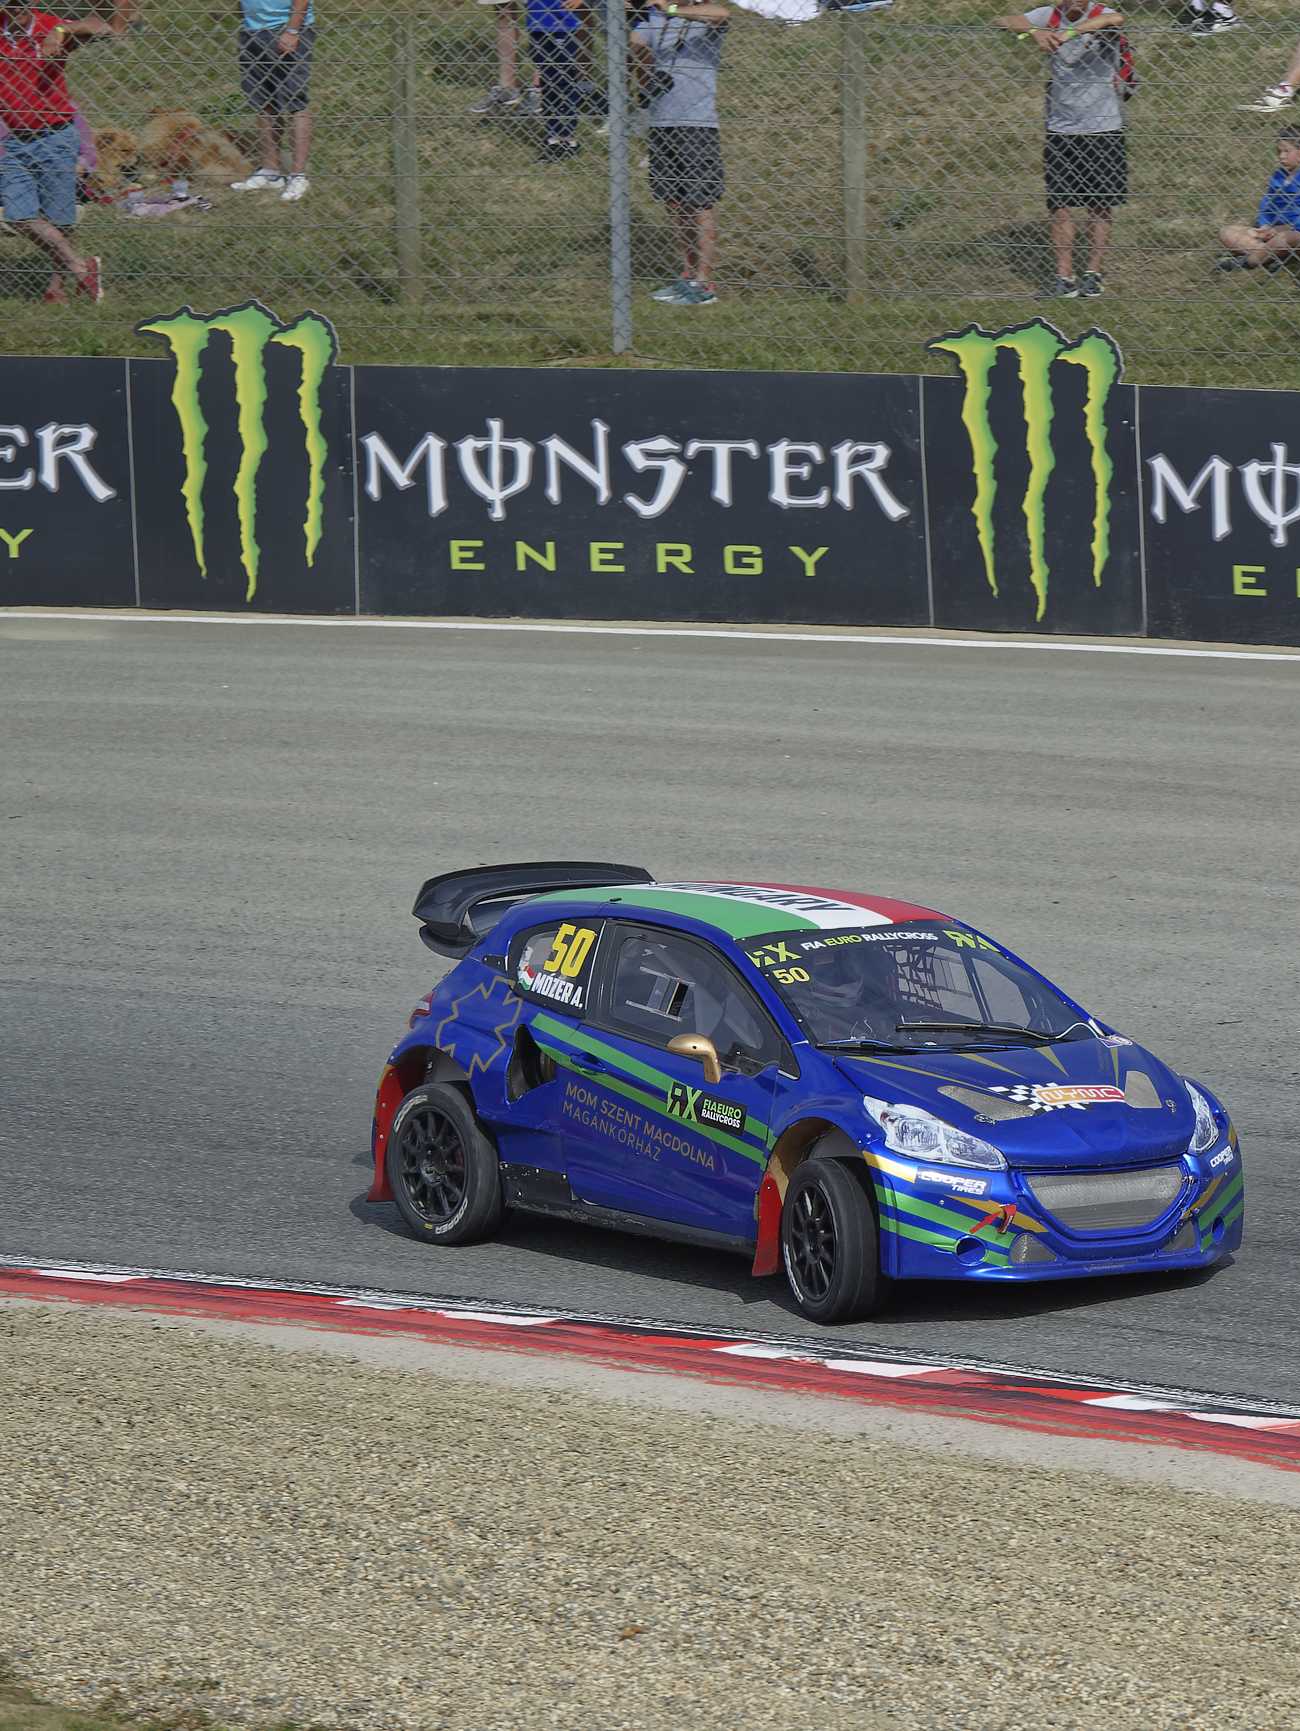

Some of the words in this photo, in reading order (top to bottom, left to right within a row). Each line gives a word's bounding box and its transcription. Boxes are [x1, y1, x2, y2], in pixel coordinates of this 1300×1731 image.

[450, 539, 829, 577] ENERGY
[660, 883, 856, 911] NGARY
[543, 923, 596, 977] 50
[800, 938, 826, 951] FIA
[824, 934, 863, 947] EURO
[861, 930, 939, 943] RALLYCROSS
[772, 967, 810, 984] 50
[565, 1081, 598, 1109] MOM
[600, 1099, 642, 1130] SZENT
[643, 1120, 716, 1171] MAGDOLNA
[701, 1109, 741, 1129] RALLYCROSS
[919, 1170, 987, 1190] COOPER
